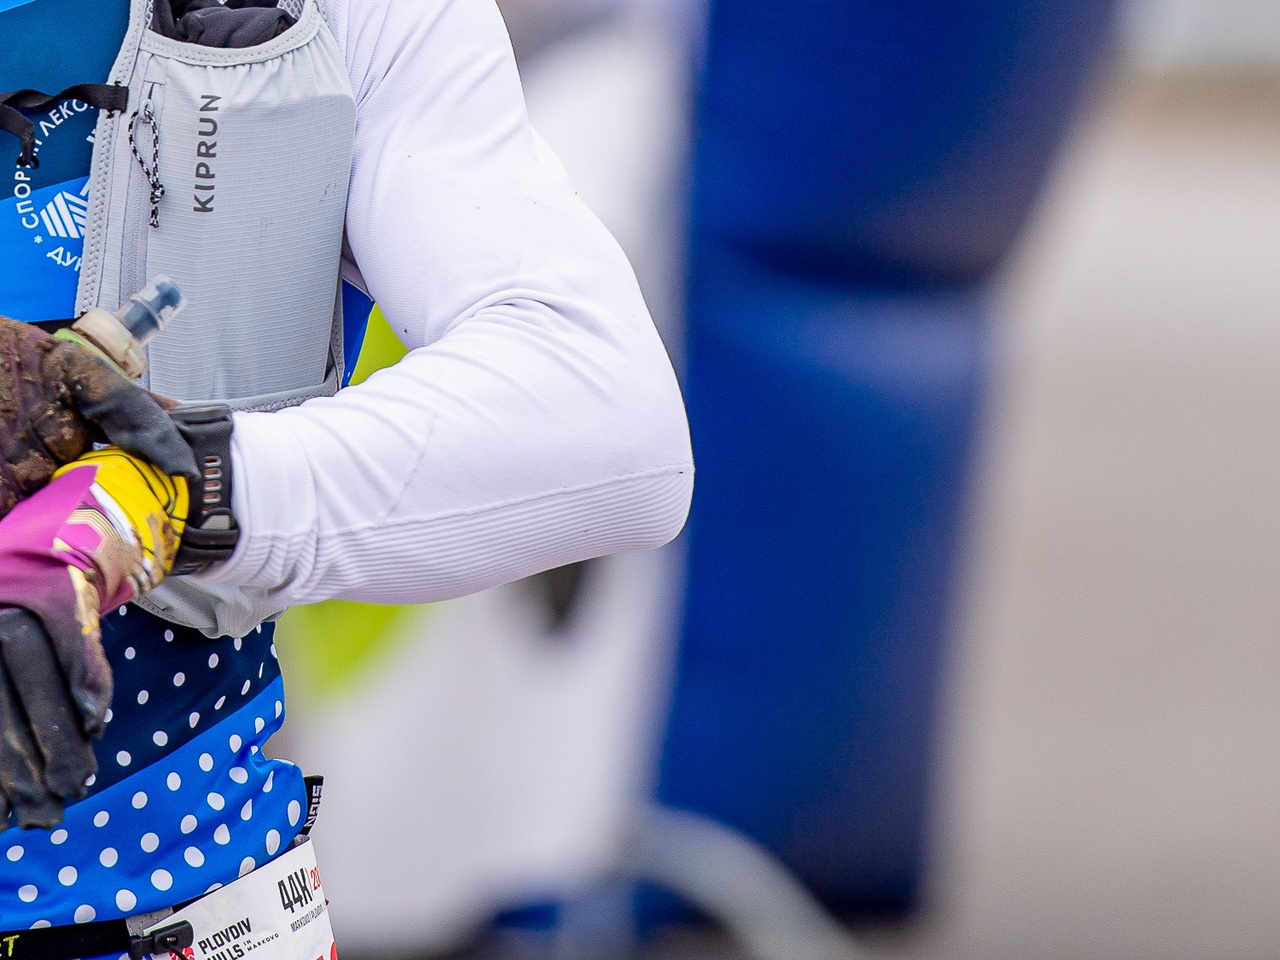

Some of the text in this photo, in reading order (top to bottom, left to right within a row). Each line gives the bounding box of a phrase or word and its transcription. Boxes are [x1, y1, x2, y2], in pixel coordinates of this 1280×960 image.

[193, 94, 222, 213] KIPRUN
[277, 868, 313, 913] 44K
[197, 917, 252, 955] PLOVDIV
[246, 932, 280, 952] MARKOVO
